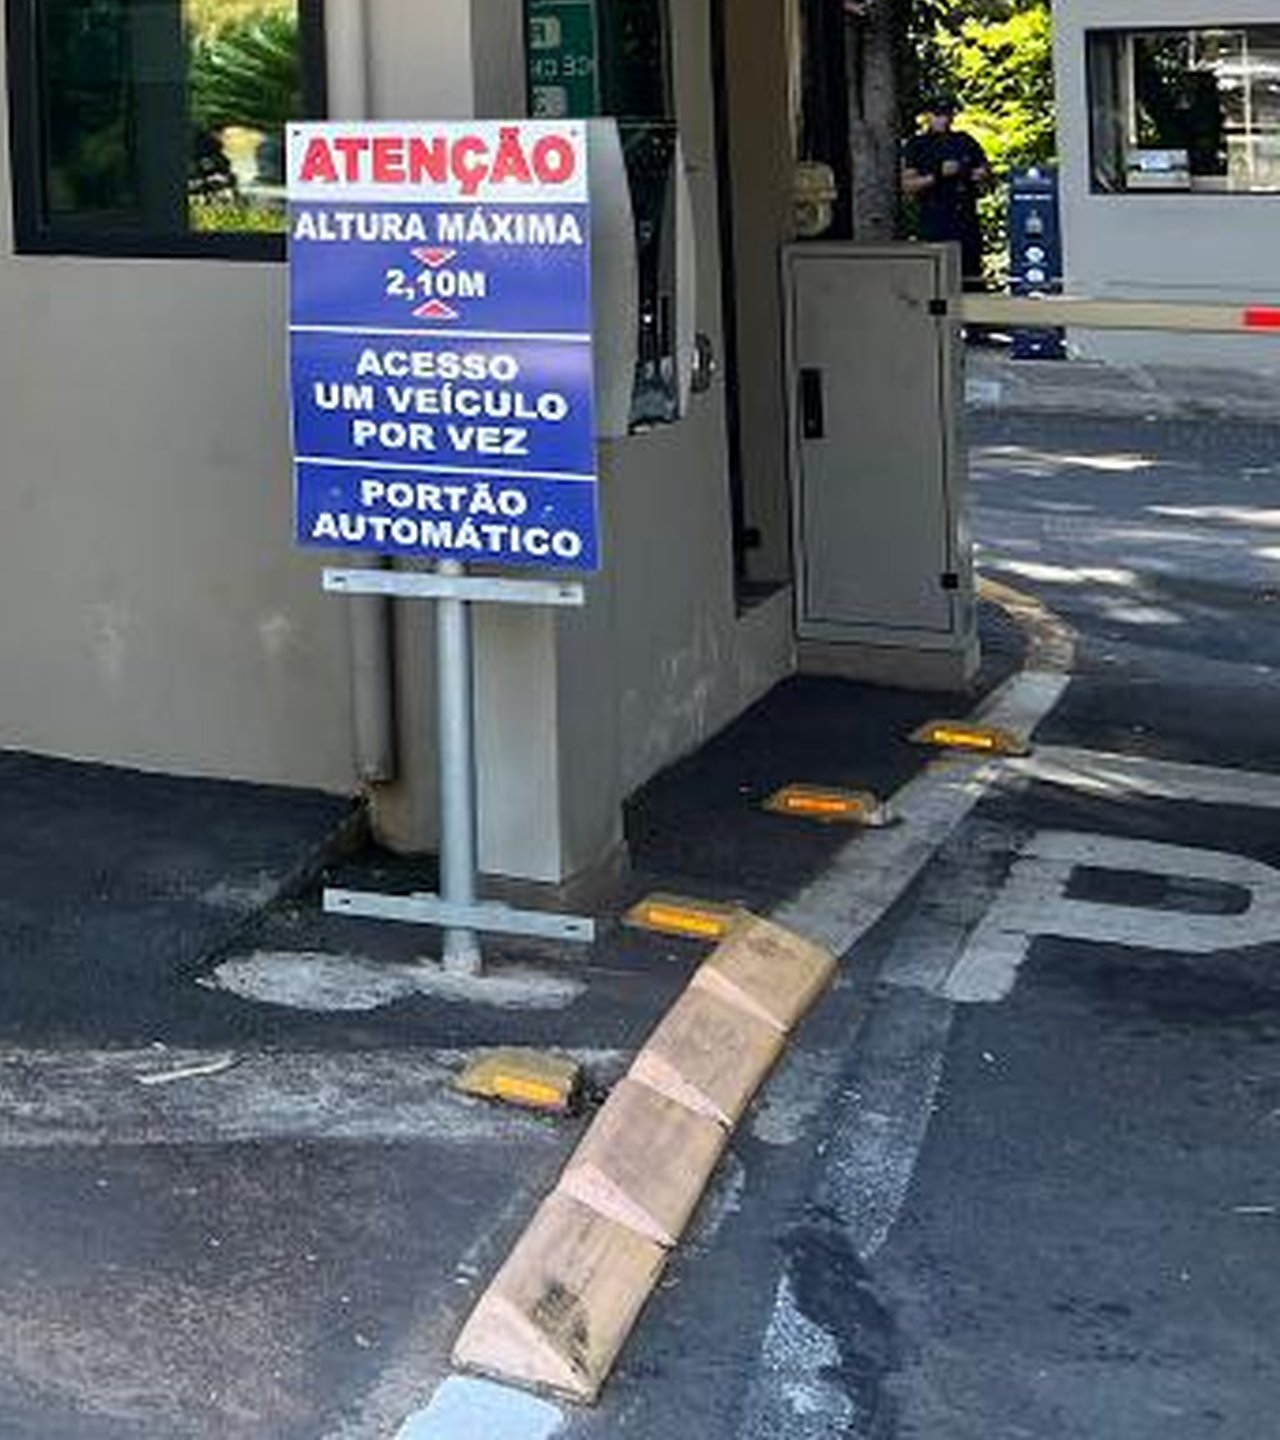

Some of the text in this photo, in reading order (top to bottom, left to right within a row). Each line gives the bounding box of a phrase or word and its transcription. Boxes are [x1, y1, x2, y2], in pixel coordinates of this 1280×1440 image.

[300, 126, 575, 194] ATENÇÃO
[295, 207, 582, 245] ALTURA MÁXIMA
[386, 270, 486, 300] 2,10M
[356, 350, 518, 380] ACESSO
[315, 383, 568, 420] UM VEÍCULO
[354, 420, 529, 455] POR VEZ
[361, 479, 527, 515] PORTÃO
[312, 511, 581, 558] AUTOMÁTICO
